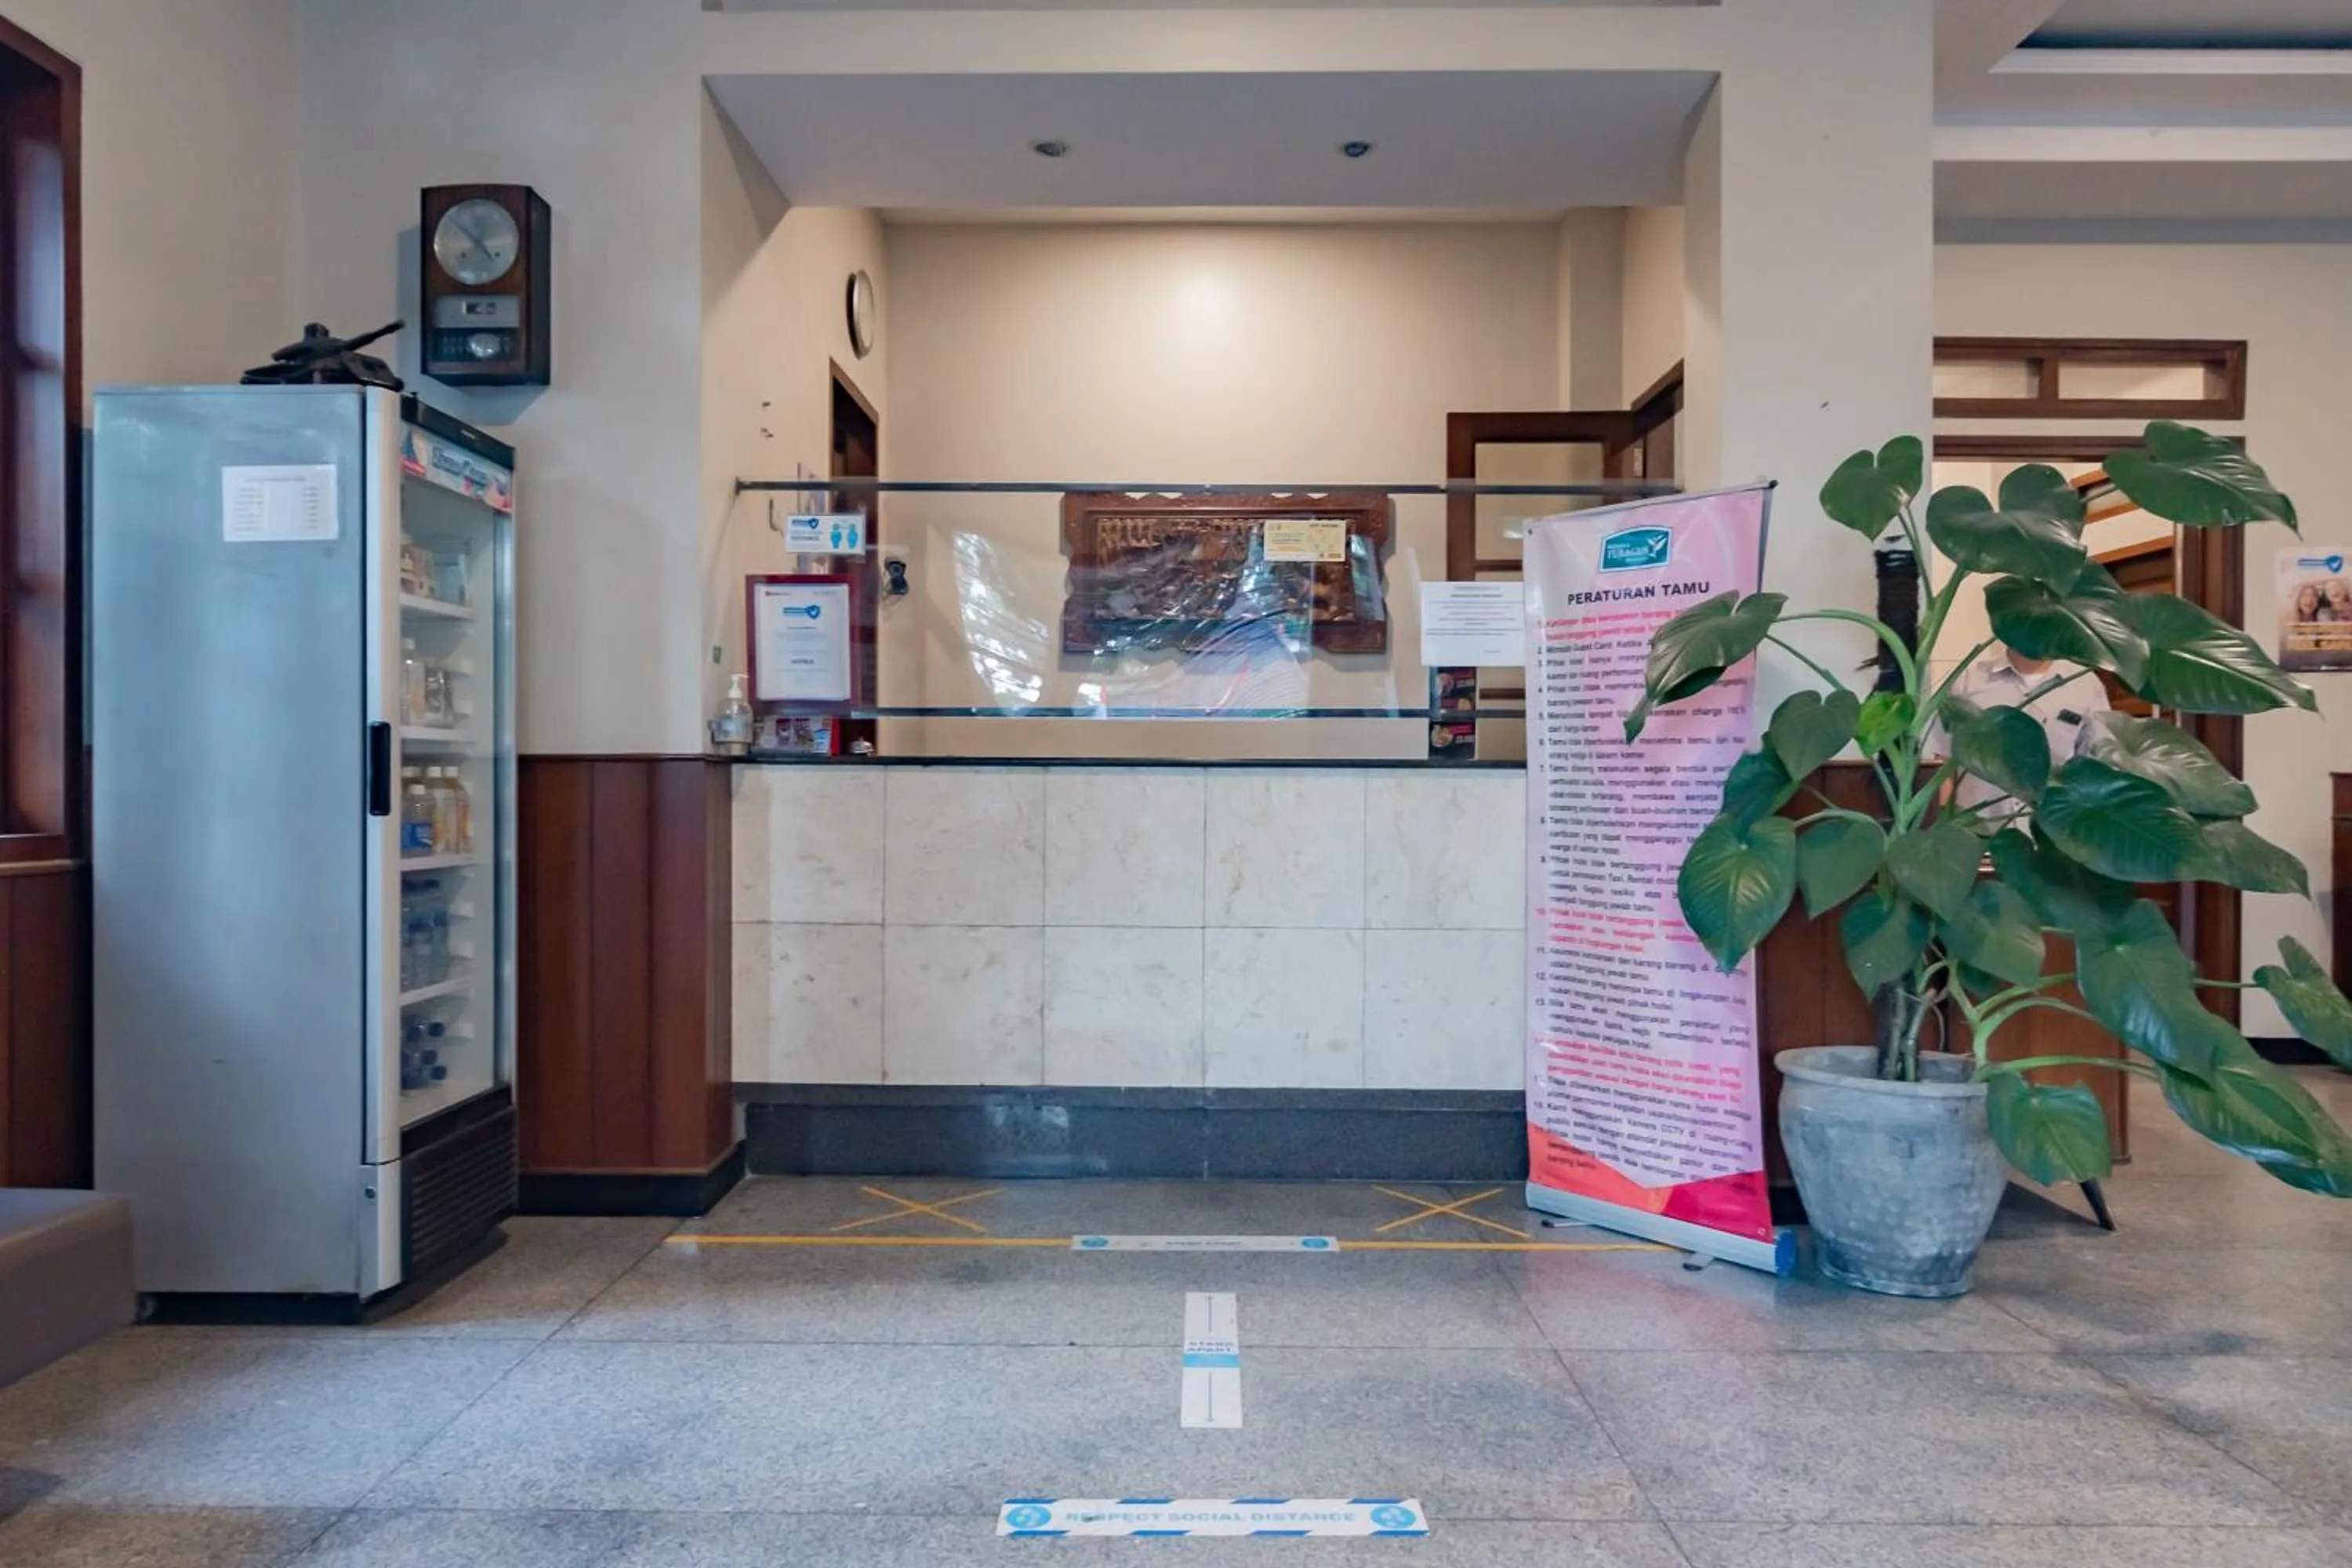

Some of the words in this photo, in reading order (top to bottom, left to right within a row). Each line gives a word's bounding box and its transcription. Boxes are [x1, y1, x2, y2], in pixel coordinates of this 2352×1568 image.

[1567, 586, 1655, 605] PERATURAN
[1661, 581, 1710, 597] TAMU
[1168, 1512, 1244, 1523] SOCIAL
[1250, 1512, 1358, 1523] DISTANCE
